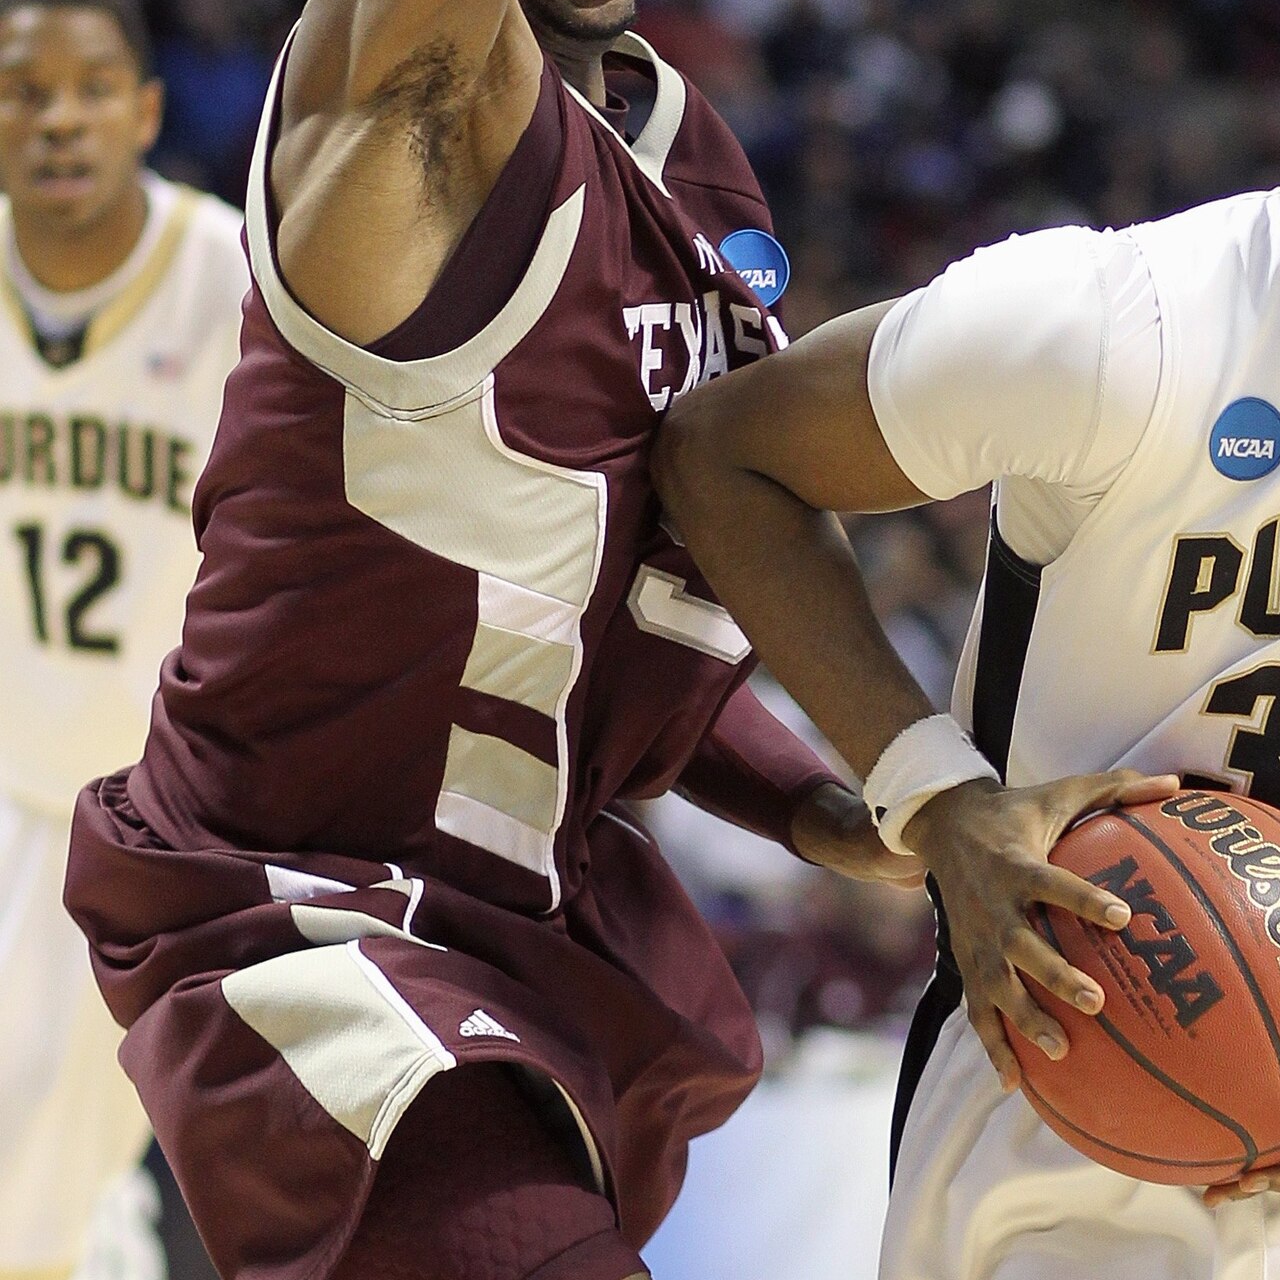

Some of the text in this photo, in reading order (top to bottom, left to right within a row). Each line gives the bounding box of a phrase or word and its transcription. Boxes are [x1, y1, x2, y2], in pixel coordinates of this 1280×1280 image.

[735, 269, 777, 288] CAA
[1218, 437, 1274, 460] NCAA
[16, 522, 122, 652] 12
[1086, 854, 1226, 1028] NCAA
